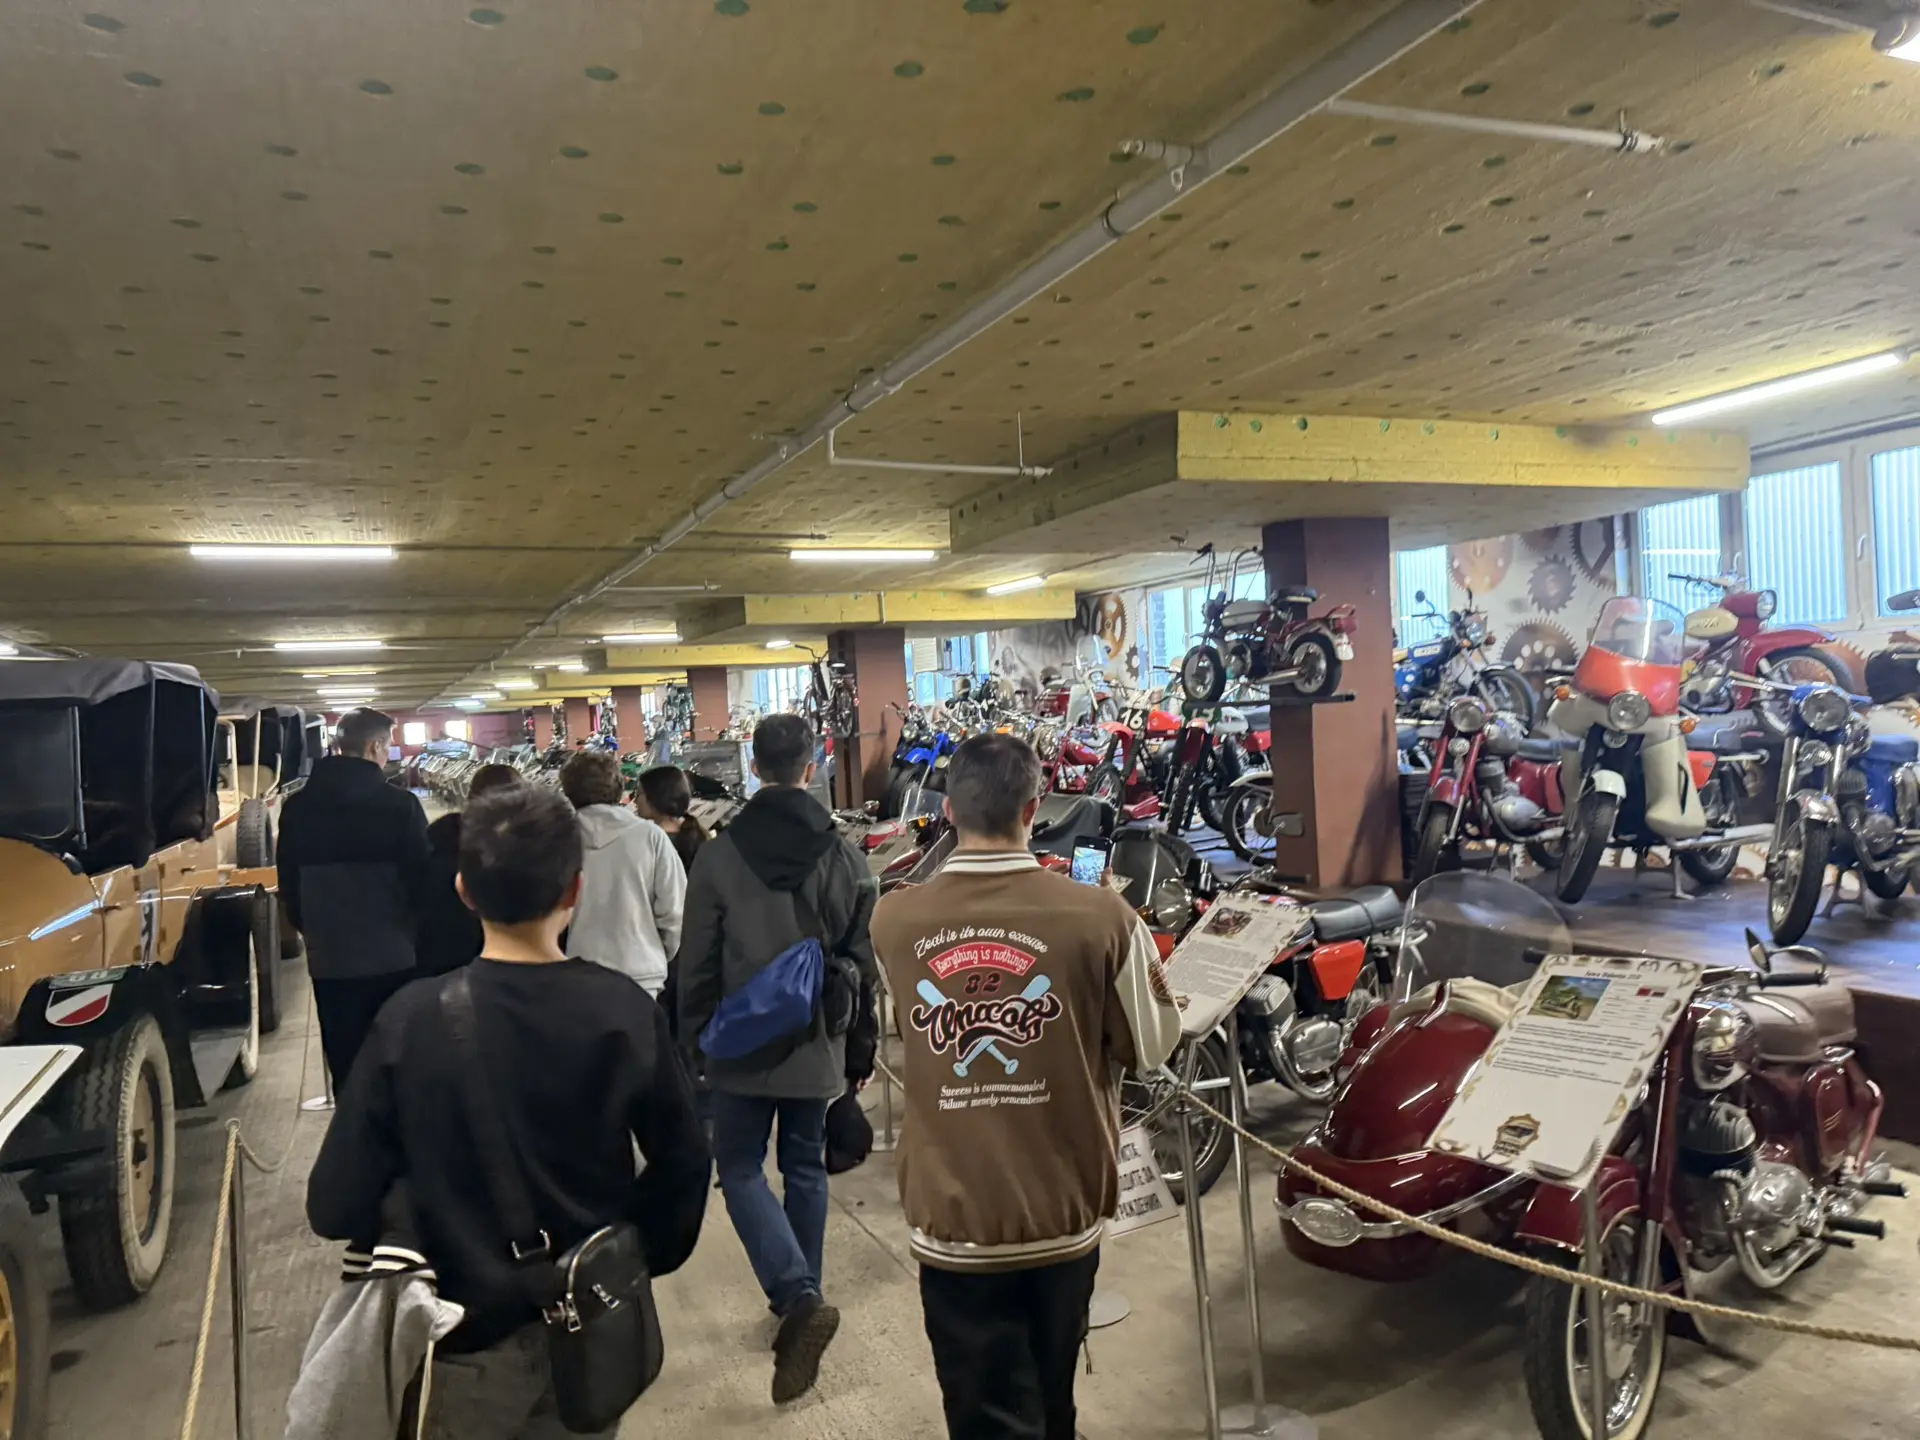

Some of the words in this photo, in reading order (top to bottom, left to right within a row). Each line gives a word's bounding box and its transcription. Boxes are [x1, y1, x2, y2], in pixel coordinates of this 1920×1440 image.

[1120, 708, 1143, 730] 16
[914, 927, 945, 959] Zeal
[946, 929, 958, 942] is
[960, 925, 976, 939] its
[977, 928, 1006, 938] own
[1008, 930, 1048, 953] excuse
[934, 948, 979, 973] Everything
[980, 946, 990, 960] is
[992, 948, 1029, 972] nothings
[940, 1084, 972, 1097] Success
[973, 1082, 980, 1094] is
